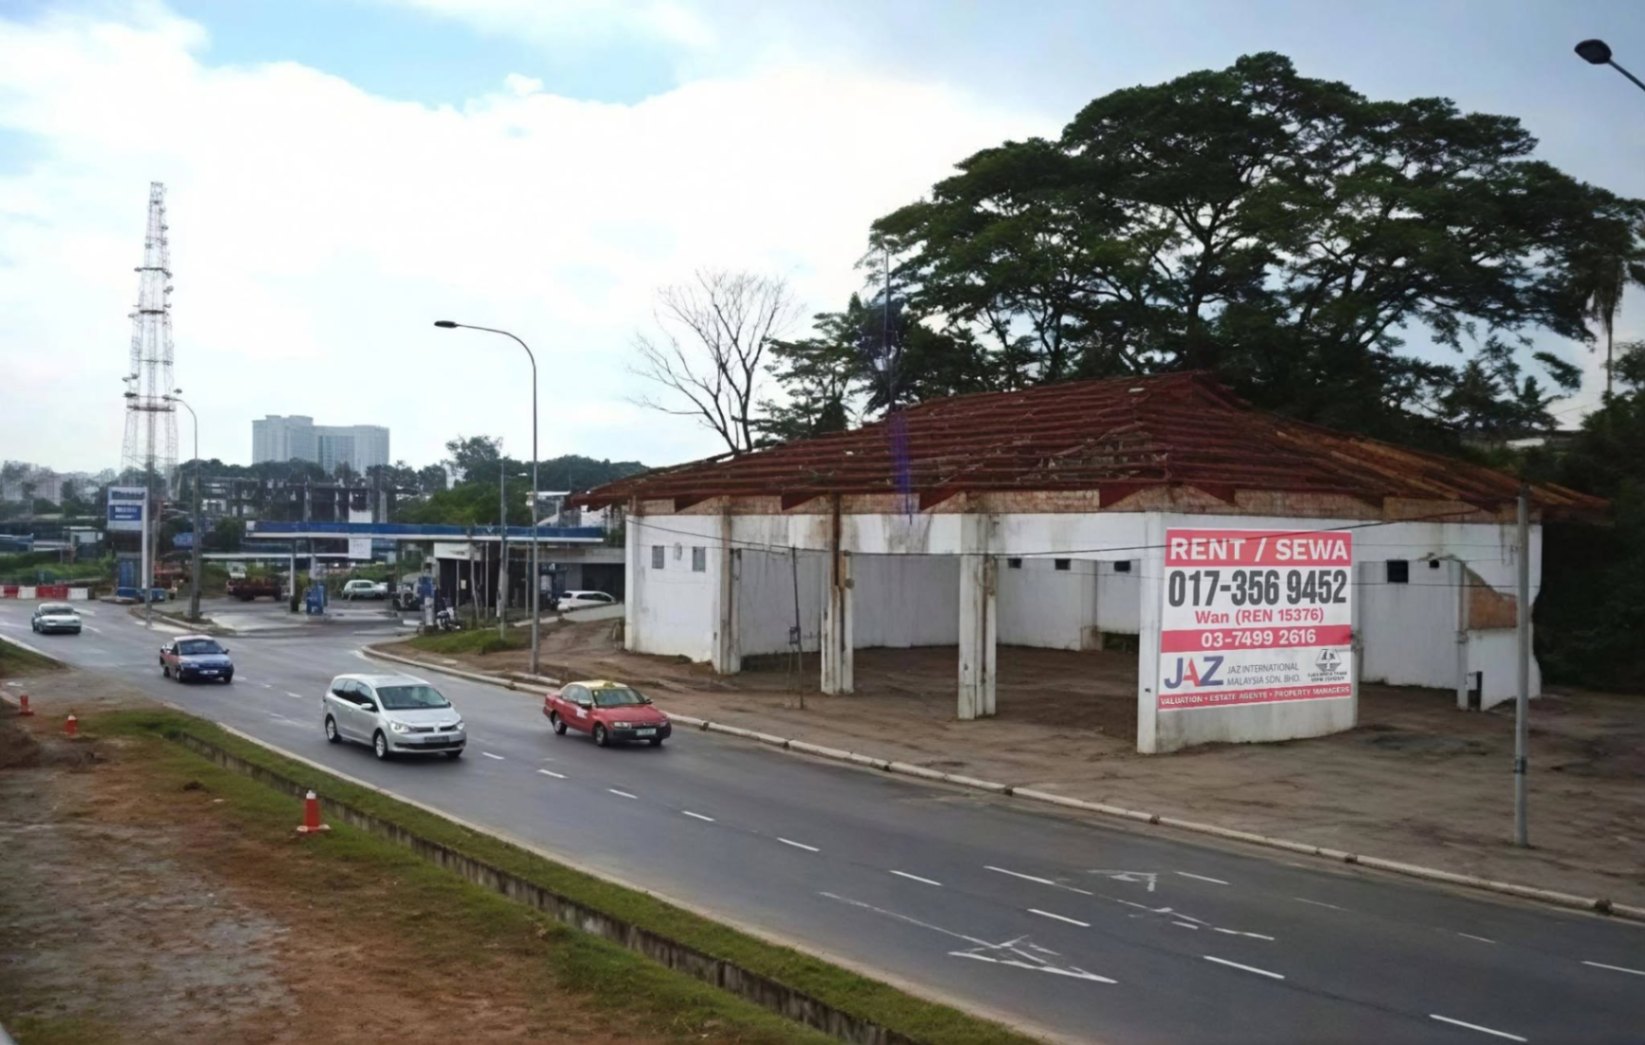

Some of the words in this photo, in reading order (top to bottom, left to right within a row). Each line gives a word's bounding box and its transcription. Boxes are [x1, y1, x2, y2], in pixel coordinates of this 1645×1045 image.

[1170, 537, 1246, 560] RENT
[1254, 537, 1267, 562] /
[1275, 539, 1348, 560] SEWA
[1168, 569, 1280, 607] 017-356
[1286, 569, 1348, 605] 9452
[1195, 610, 1229, 624] Wan
[1235, 608, 1274, 626] (REN
[1278, 607, 1324, 623] 15376)
[1201, 631, 1273, 648] 03-7499
[1279, 628, 1317, 644] 2616
[1164, 655, 1224, 689] JAZ
[1227, 665, 1242, 674] JAZ
[1242, 661, 1299, 674] INTERNATIONAL
[1226, 675, 1264, 686] MALAYSIA
[1160, 695, 1203, 705] VALUATION
[1209, 692, 1236, 702] ESTATE
[1274, 687, 1311, 698] PROPERTY
